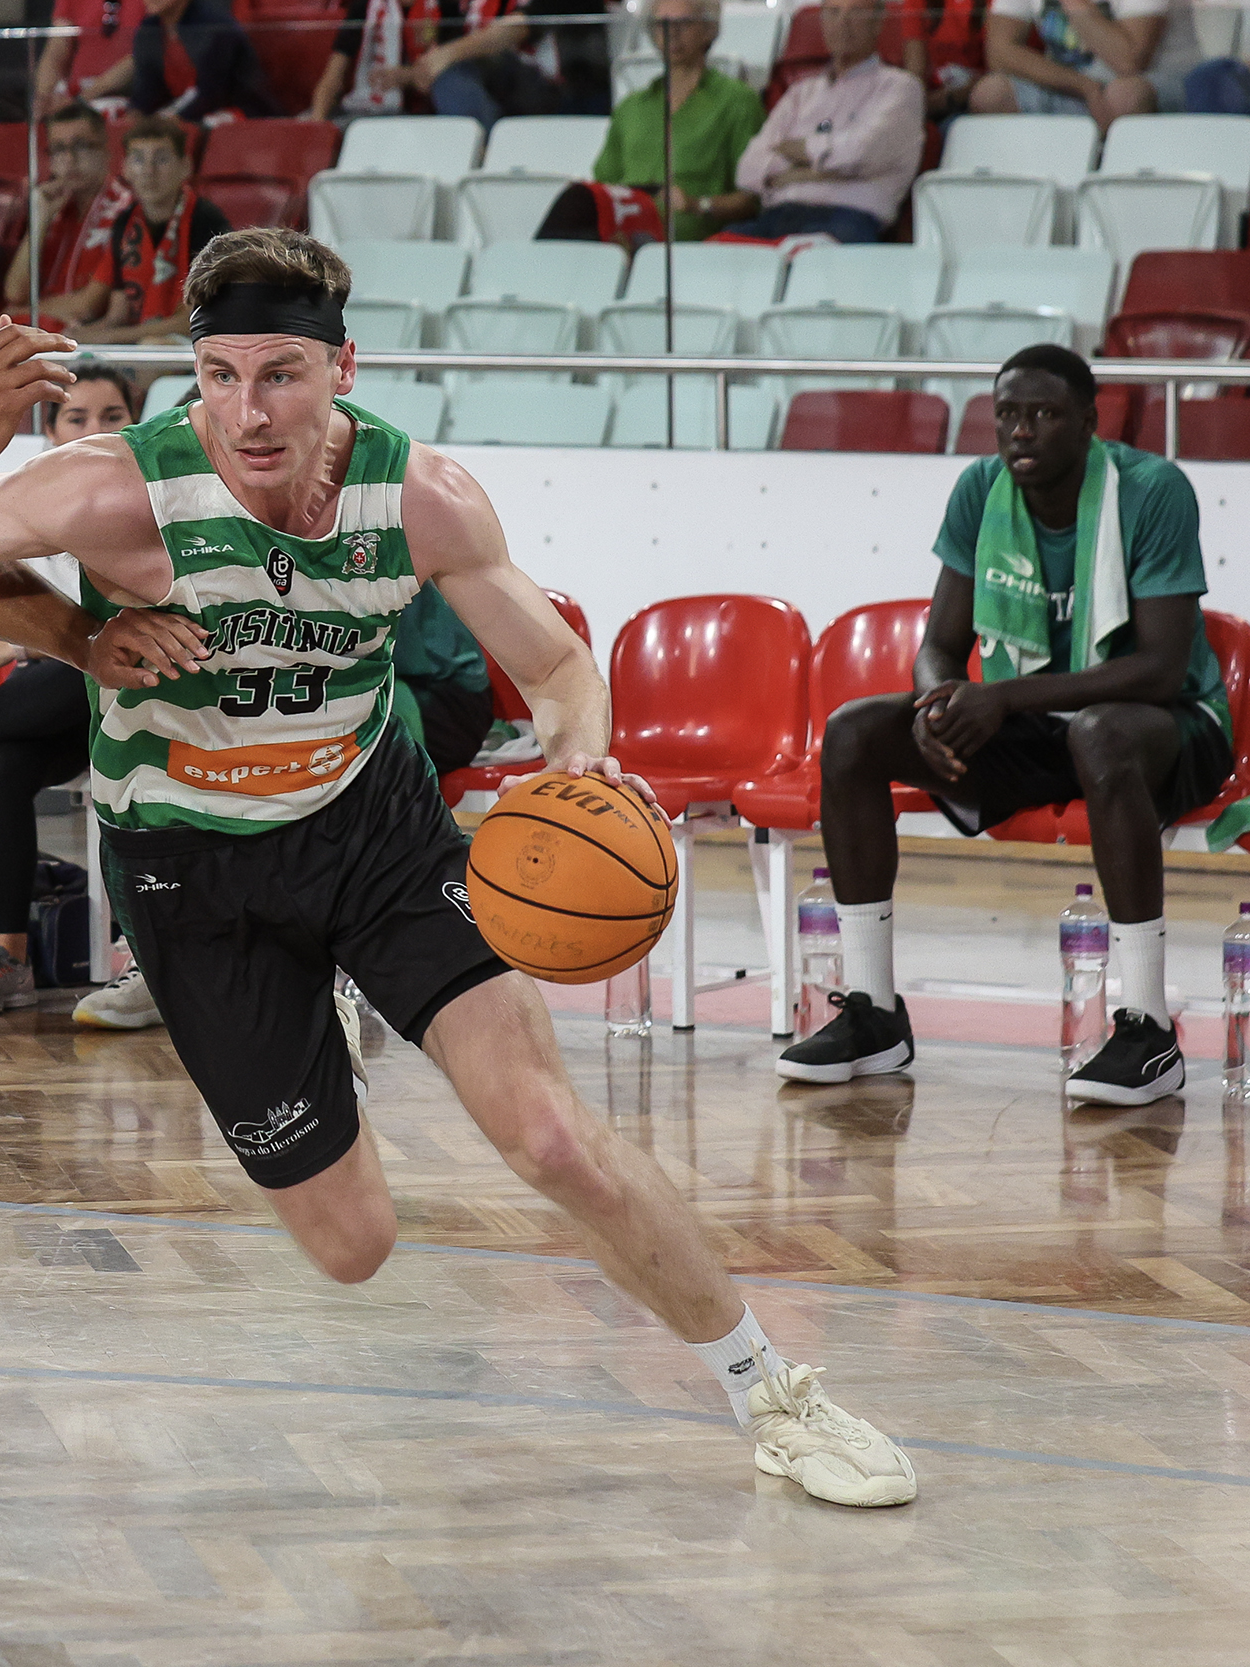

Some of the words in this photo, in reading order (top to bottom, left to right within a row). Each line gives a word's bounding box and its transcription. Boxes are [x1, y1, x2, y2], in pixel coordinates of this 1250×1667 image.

[181, 544, 234, 557] DHIKA
[986, 567, 1046, 595] DHIK
[218, 661, 334, 718] 33
[184, 761, 302, 784] expert
[530, 781, 615, 817] EVO
[135, 882, 182, 893] DHIKA
